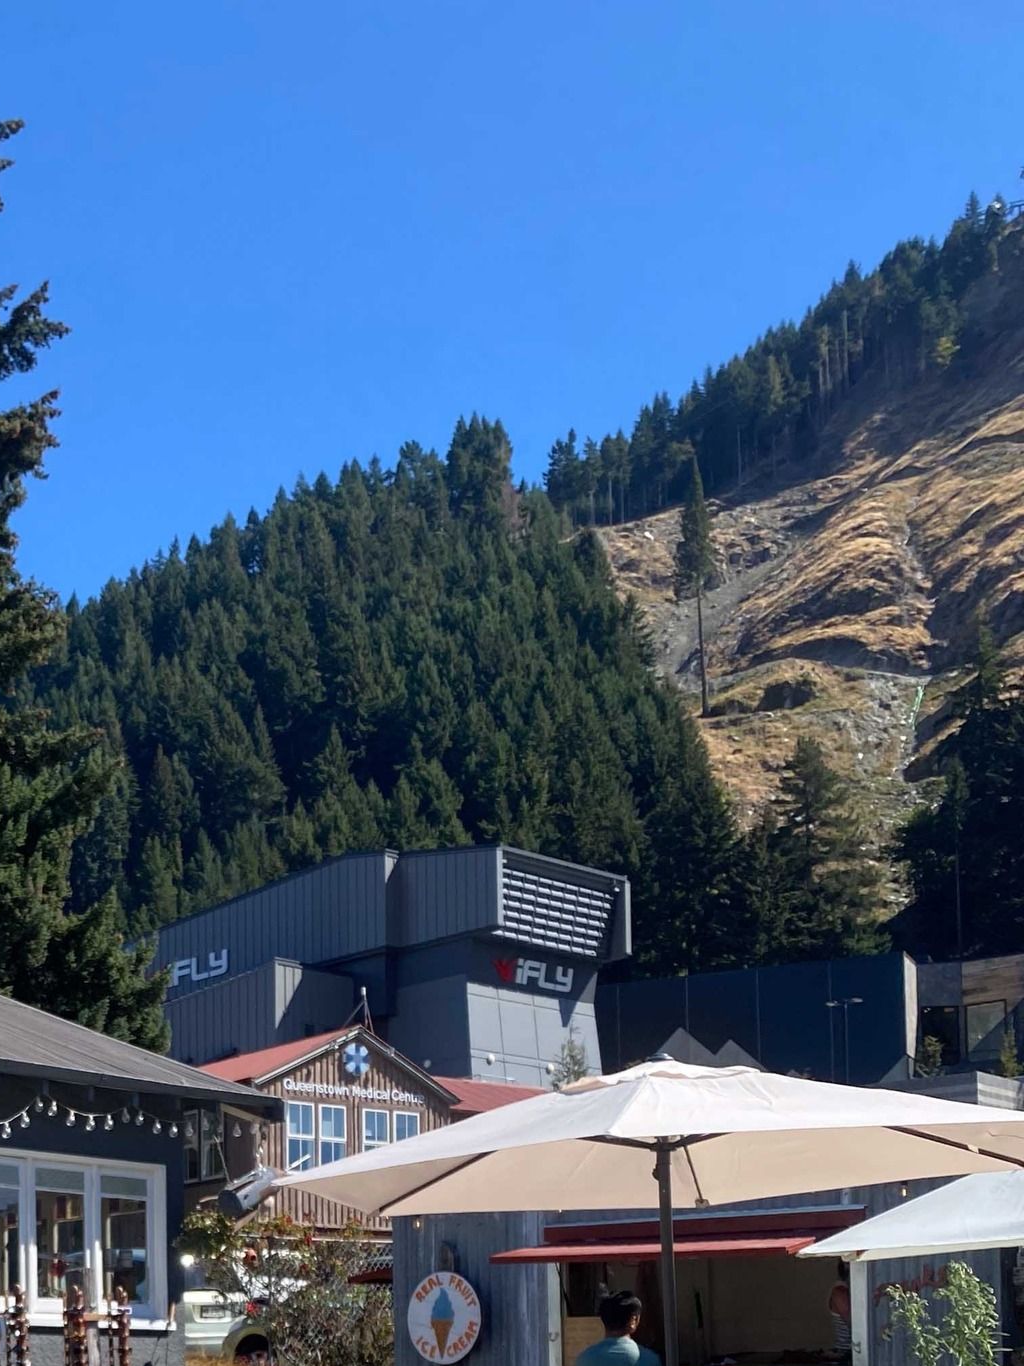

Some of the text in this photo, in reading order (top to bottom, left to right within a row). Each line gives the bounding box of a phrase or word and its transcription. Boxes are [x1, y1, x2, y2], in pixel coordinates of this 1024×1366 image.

[282, 1078, 425, 1104] Queenstown Medical Centre
[415, 1274, 478, 1307] REAL FRUIT
[416, 1320, 479, 1359] ICE CREAM
